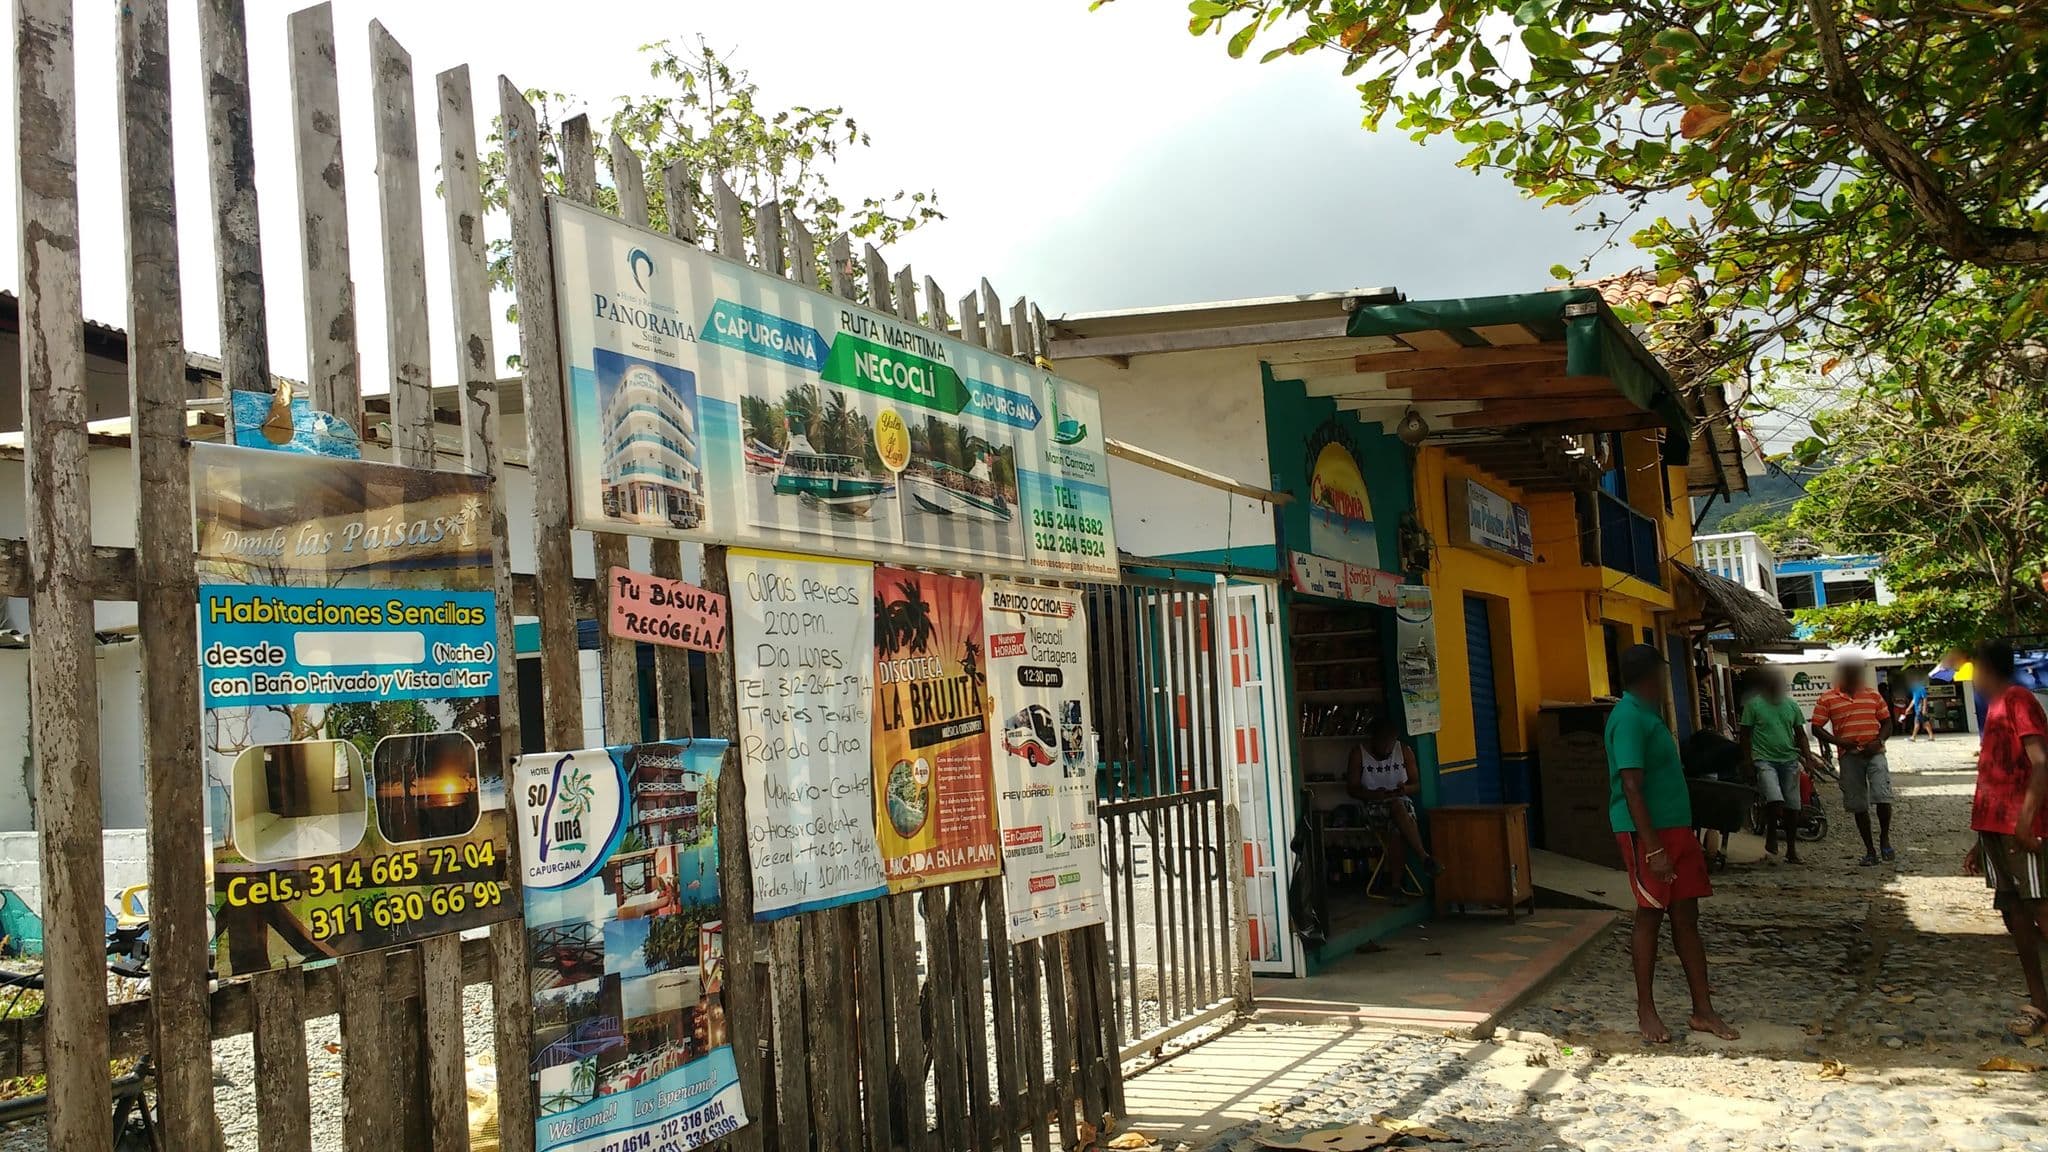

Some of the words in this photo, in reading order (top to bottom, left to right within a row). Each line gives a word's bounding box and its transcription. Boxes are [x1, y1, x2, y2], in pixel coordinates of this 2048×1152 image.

[594, 293, 698, 344] PANORAMA
[714, 311, 817, 361] CAPURGANÁ
[841, 310, 880, 345] RUTA
[882, 324, 947, 363] MARITIMA
[853, 350, 936, 399] NECOCLÍ
[1054, 485, 1078, 510] TEL:
[1033, 509, 1054, 528] 315
[1056, 513, 1077, 532] 244
[1079, 516, 1104, 536] 6382
[221, 526, 288, 557] Donde
[294, 524, 334, 558] las
[341, 515, 447, 553] Paisas
[1035, 532, 1056, 552] 312
[1059, 536, 1078, 554] 264
[1080, 538, 1105, 558] 5924
[747, 572, 797, 603] CUPOS
[209, 596, 382, 625] Habitaciones
[386, 600, 486, 626] Sencillas
[993, 592, 1028, 610] RAPIDO
[1031, 597, 1062, 614] OCHOA
[764, 611, 800, 636] 2:00
[994, 644, 1025, 657] HORARIO
[998, 634, 1017, 644] Nuevo
[206, 641, 285, 666] desde
[431, 641, 495, 666] (Noche)
[1031, 645, 1078, 666] Cartagena
[210, 676, 249, 697] con
[254, 672, 307, 696] Baño
[311, 672, 377, 695] Privado
[379, 674, 392, 694] y
[395, 668, 438, 690] Vista
[454, 668, 491, 689] Mar
[879, 655, 944, 684] DISCOTECA
[1023, 669, 1044, 683] 12:30
[1045, 671, 1059, 686] pm
[880, 684, 905, 731] LA
[909, 674, 983, 726] BRUJITA
[531, 767, 550, 777] HOTEL
[1004, 832, 1016, 843] En
[529, 859, 582, 877] CAPURGANA
[937, 849, 951, 868] EN
[952, 848, 965, 866] LA
[967, 843, 997, 864] PLAYA
[227, 871, 301, 907] Cels.
[310, 860, 363, 897] 314
[371, 852, 419, 886] 665
[429, 846, 462, 876] 72
[464, 840, 495, 870] 04
[311, 903, 363, 940] 311
[373, 892, 424, 928] 630
[431, 886, 465, 915] 66
[473, 880, 502, 908] 99
[549, 1102, 619, 1141] Welcome!!
[634, 1100, 654, 1118] Los
[660, 1119, 679, 1140] 312
[681, 1111, 702, 1130] 318
[708, 1114, 738, 1138] 6396
